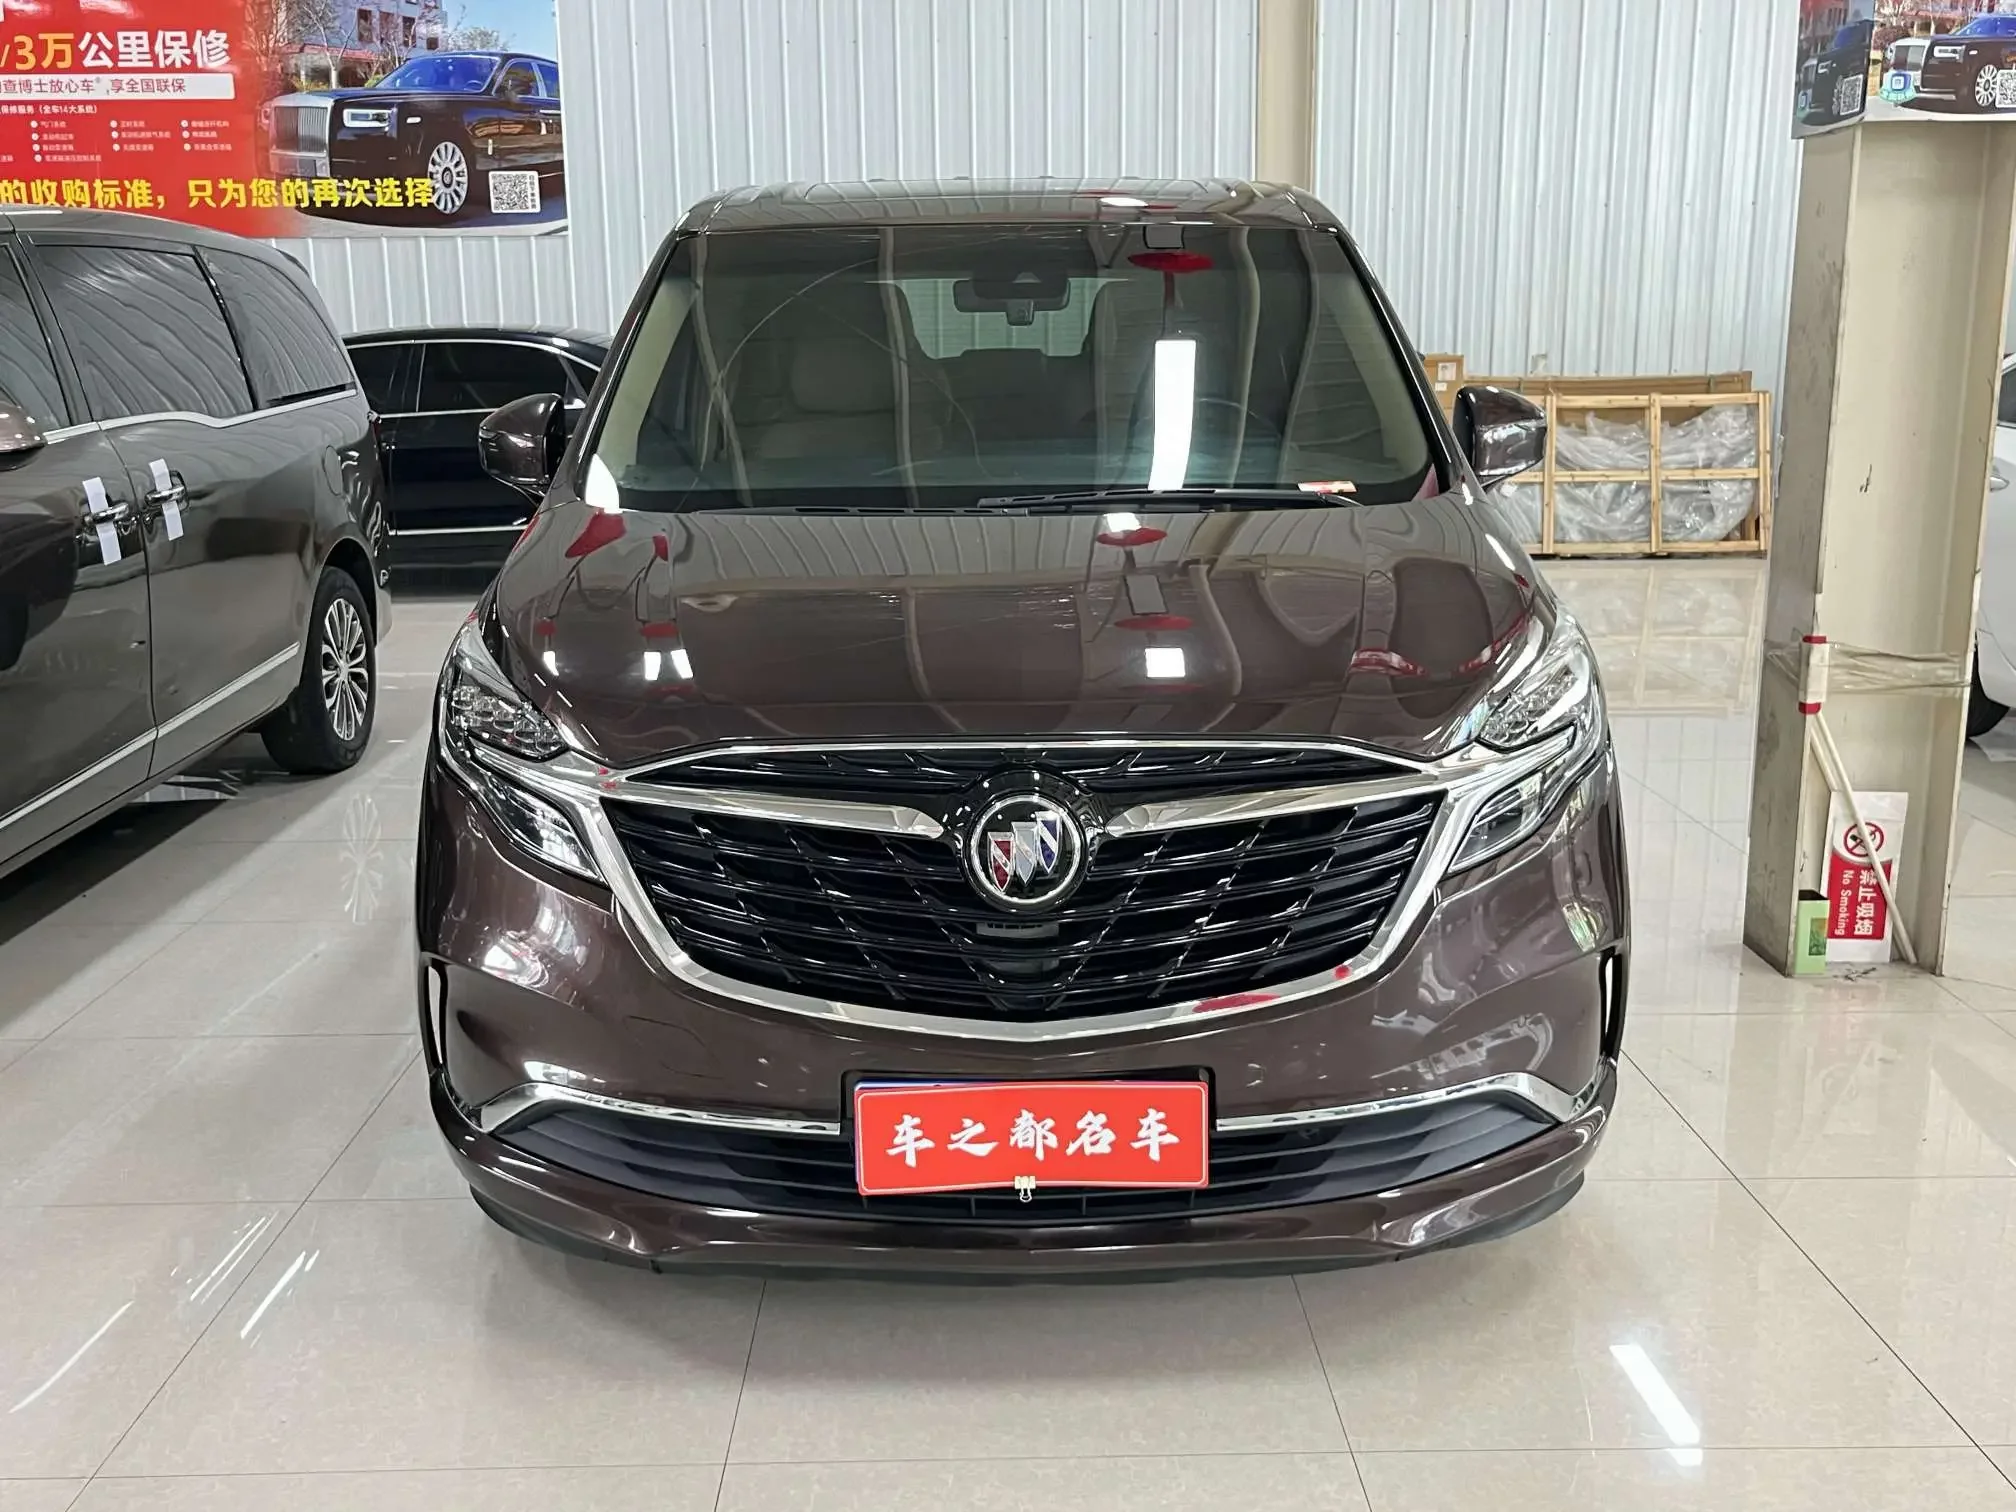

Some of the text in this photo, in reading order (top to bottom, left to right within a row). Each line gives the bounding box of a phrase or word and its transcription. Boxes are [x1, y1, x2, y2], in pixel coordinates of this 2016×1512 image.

[1834, 869, 1855, 936] No Smoking
[1853, 869, 1877, 935] 禁止吸烟
[886, 1108, 1180, 1168] 车之都名车
